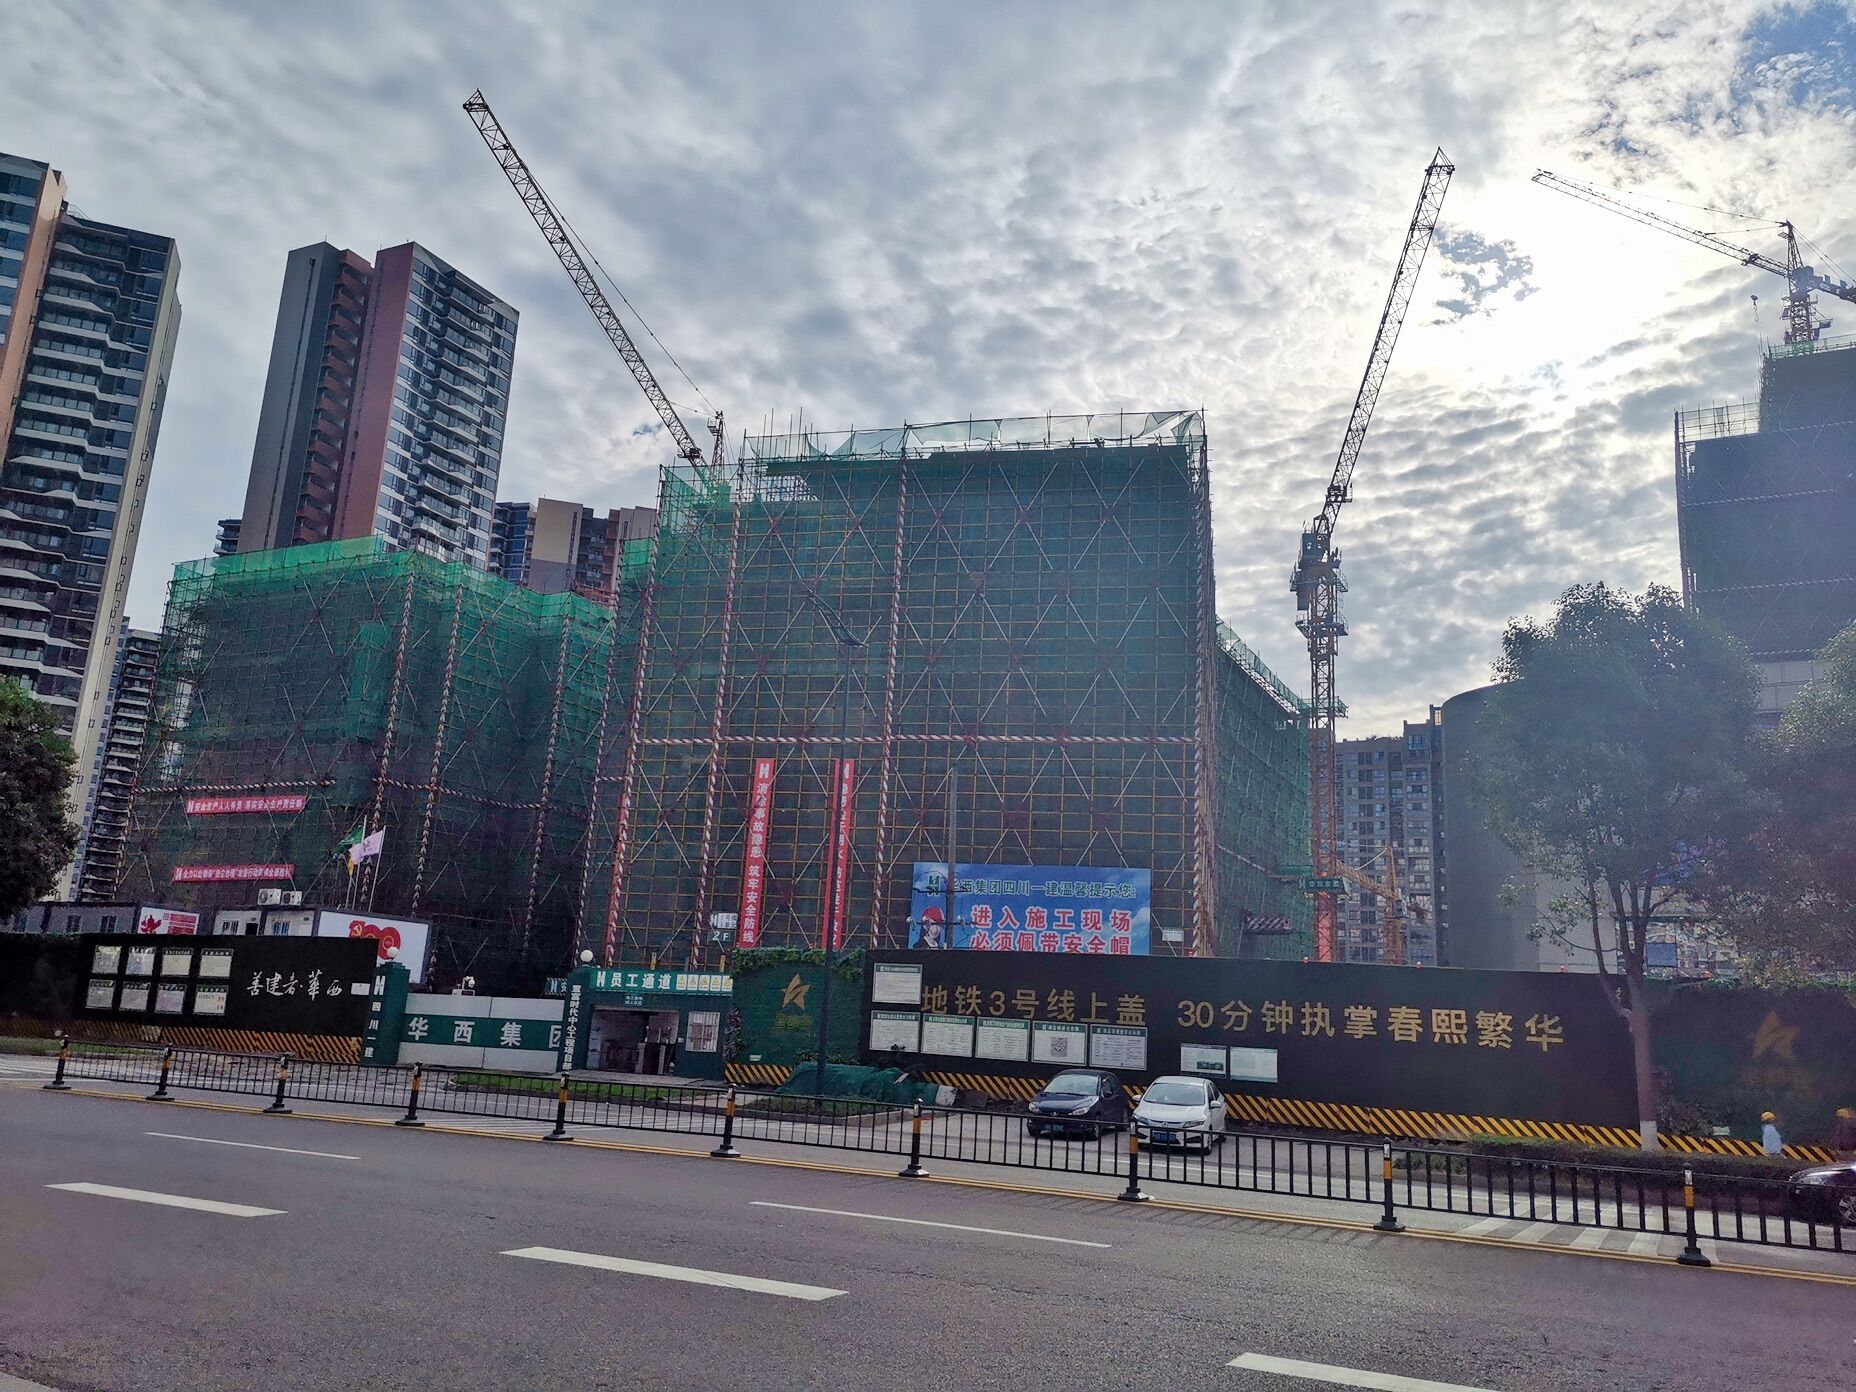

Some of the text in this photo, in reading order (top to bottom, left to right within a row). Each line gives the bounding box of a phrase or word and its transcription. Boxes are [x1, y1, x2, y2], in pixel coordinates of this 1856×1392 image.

[742, 783, 768, 944] 消除事故隐患 筑牢安全防线
[971, 905, 1132, 932] 进入施工现场
[970, 931, 1132, 955] 必须佩带安全帽
[611, 972, 672, 990] 员工通道
[921, 984, 1146, 1027] 地铁3号线上盖
[1177, 999, 1564, 1052] 30分钟执掌春熙繁华
[364, 1001, 382, 1058] 四川一建
